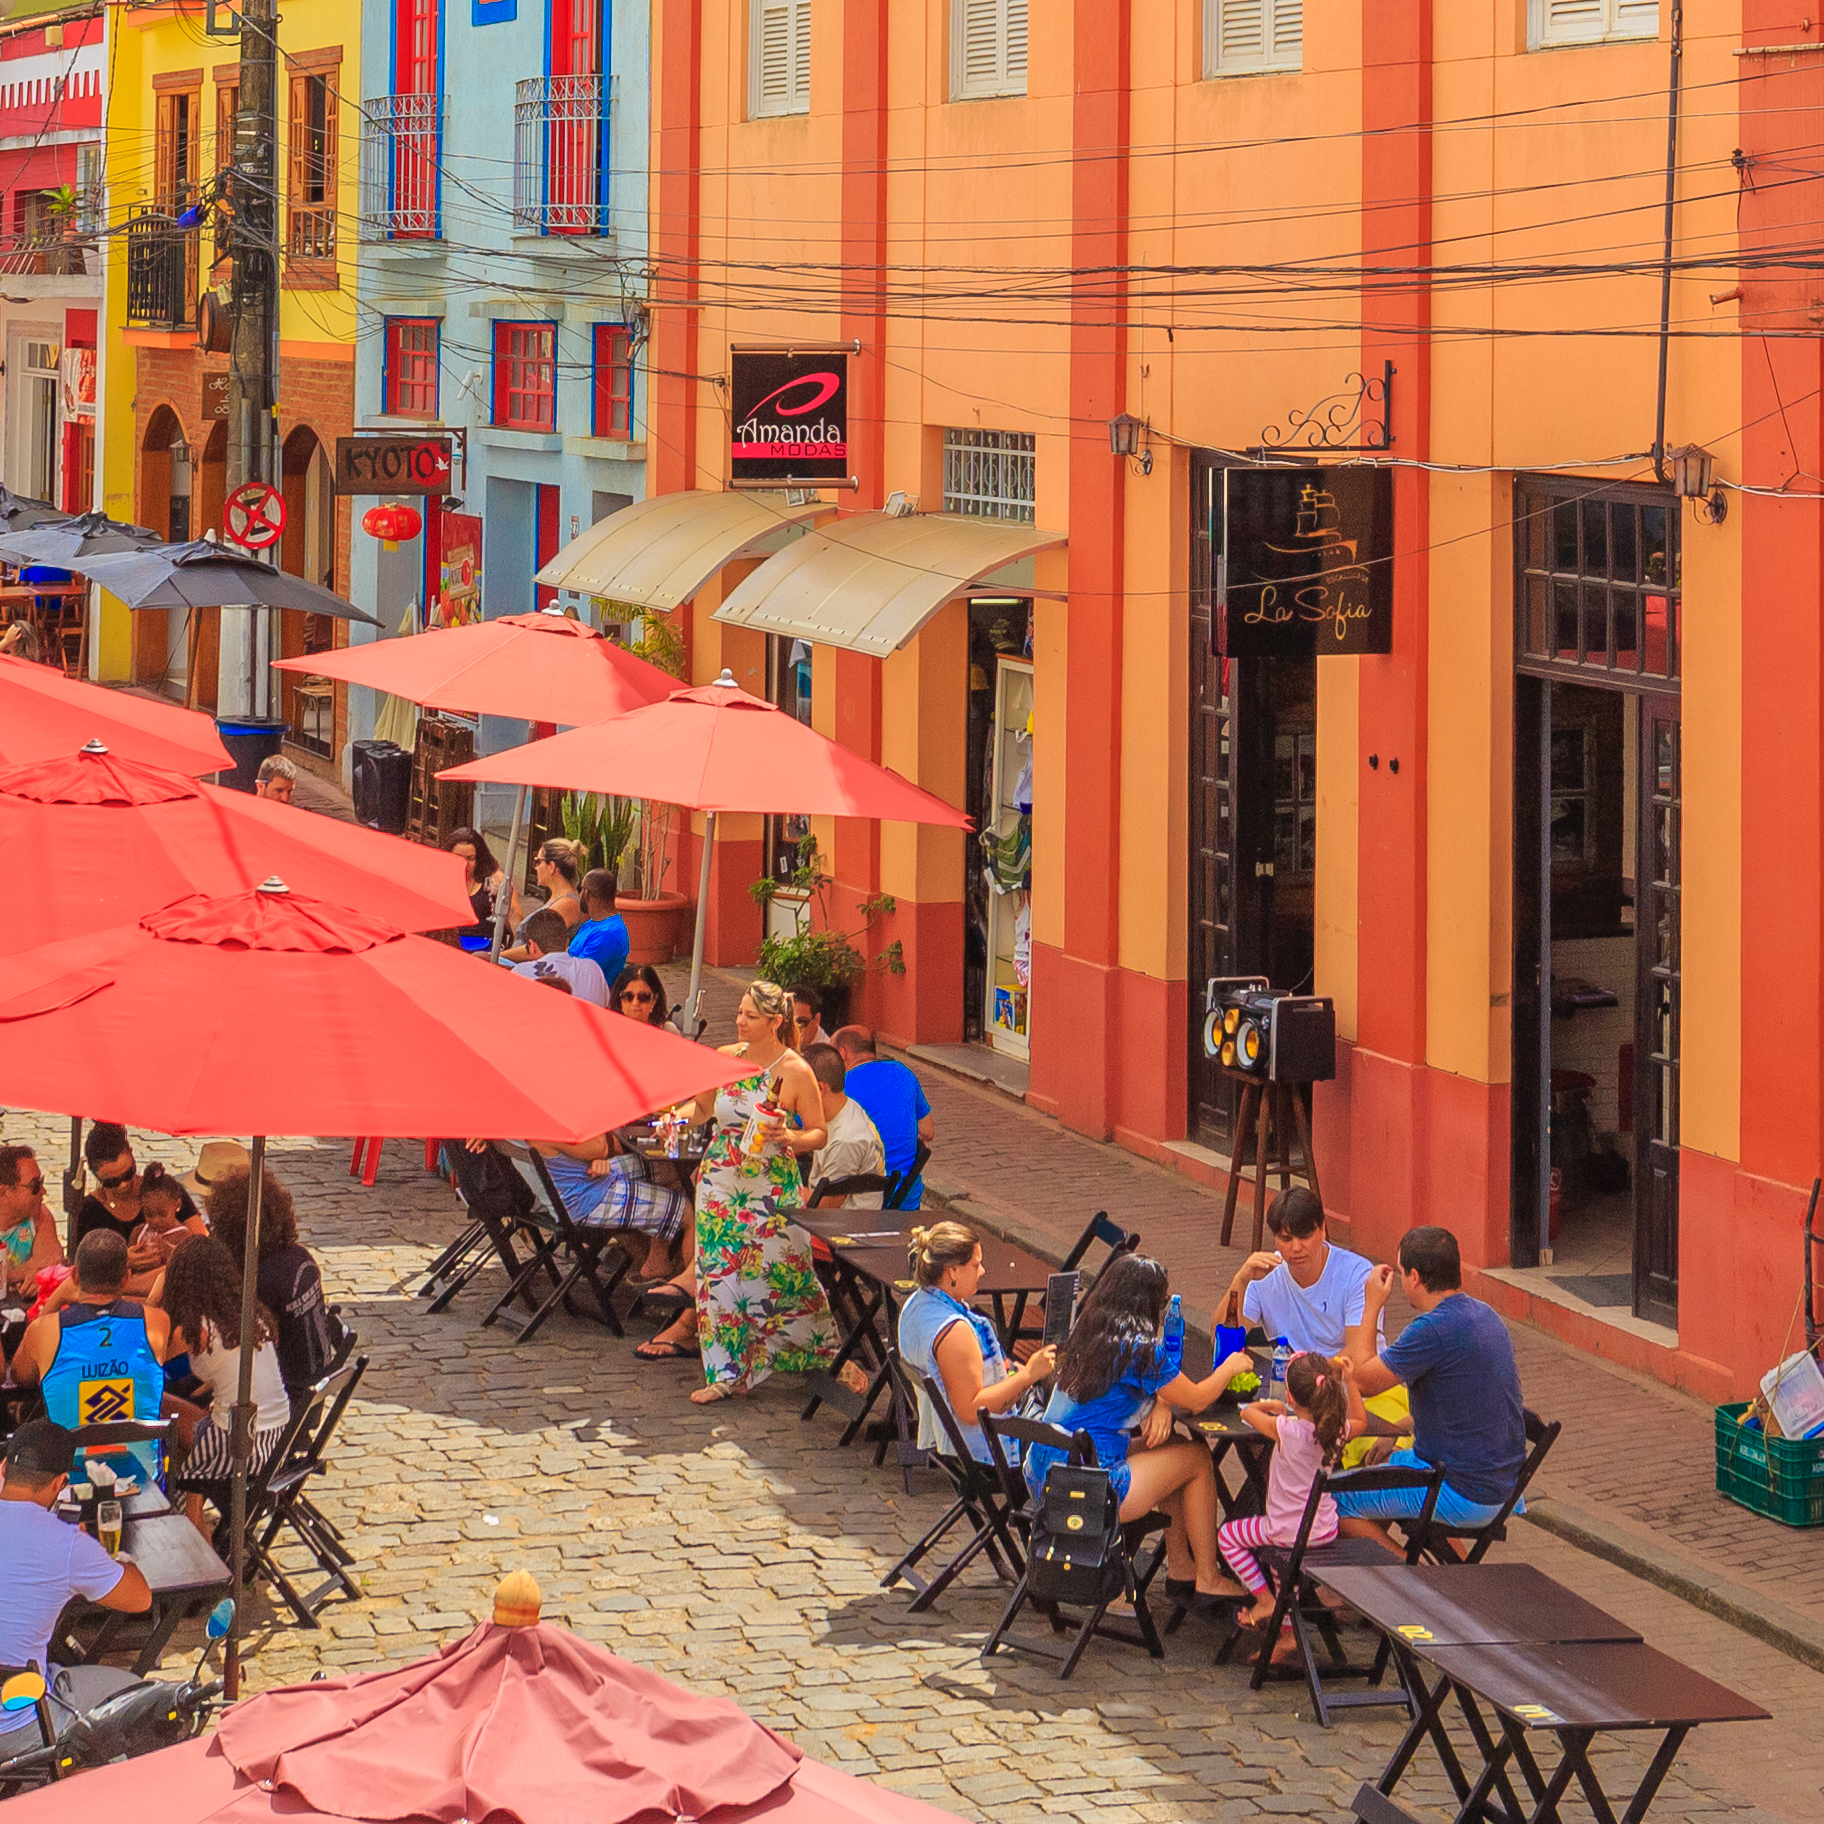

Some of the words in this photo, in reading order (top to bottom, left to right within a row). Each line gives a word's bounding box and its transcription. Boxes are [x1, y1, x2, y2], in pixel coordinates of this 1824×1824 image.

[737, 417, 843, 448] Amanda
[770, 443, 846, 456] MODAS
[345, 446, 436, 479] KYOTO
[1245, 586, 1294, 624] La
[1295, 586, 1372, 640] Sofia
[98, 1327, 113, 1347] 2
[81, 1359, 129, 1379] LUIZÃO
